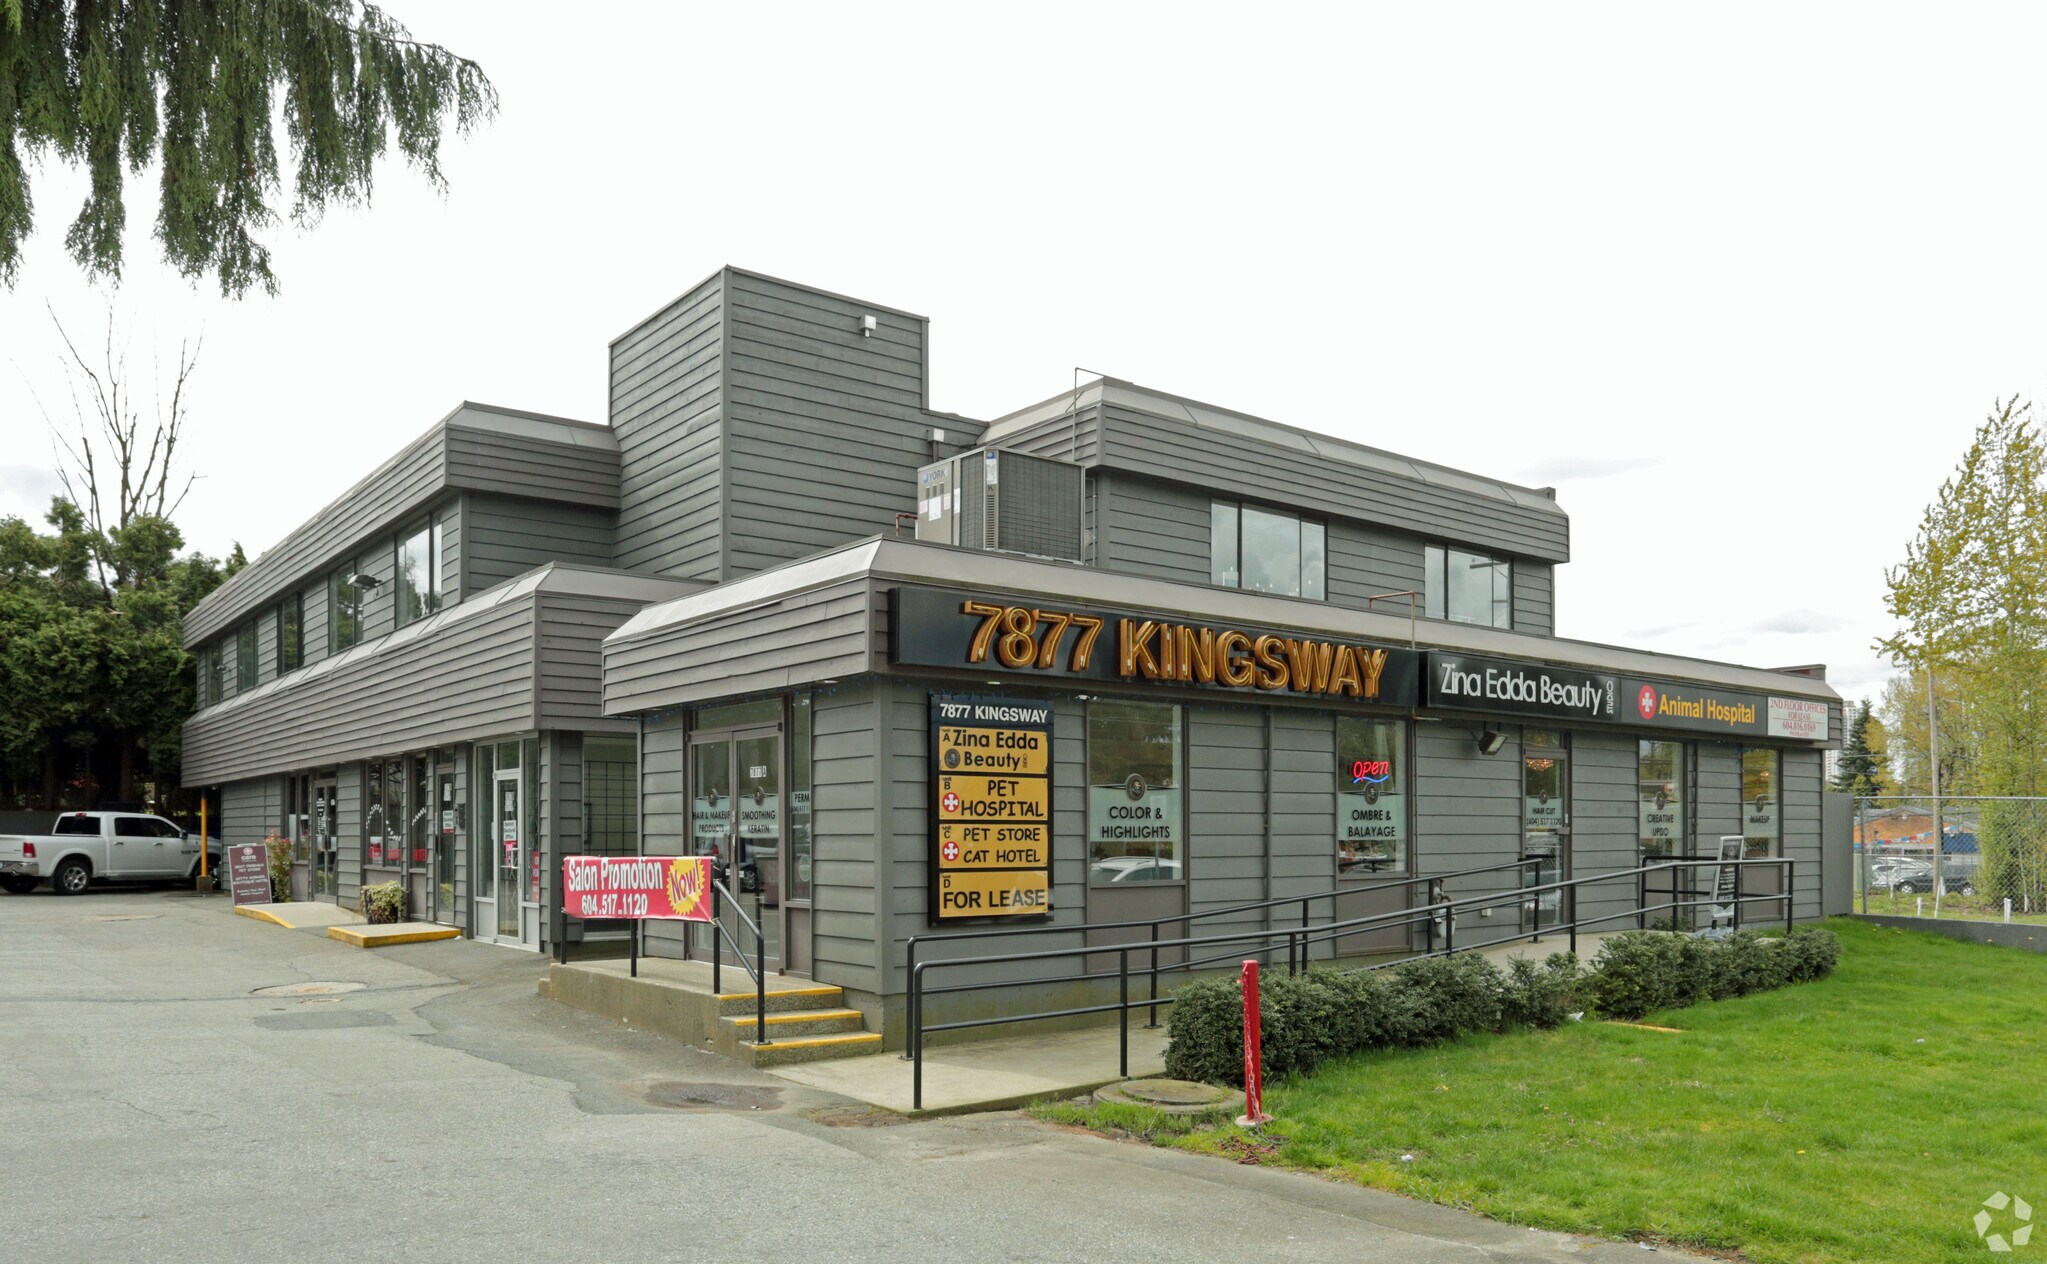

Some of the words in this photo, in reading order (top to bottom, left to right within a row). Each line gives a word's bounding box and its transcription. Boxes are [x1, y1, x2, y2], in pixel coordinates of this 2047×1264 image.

[929, 468, 946, 481] YORK
[964, 600, 1104, 672] 7877
[1120, 618, 1388, 697] KINGSWAY
[1440, 663, 1482, 696] Zina
[1486, 668, 1536, 702] Edda
[1540, 675, 1602, 716] Beauty
[1658, 694, 1704, 718] Animal
[1707, 698, 1755, 726] Hospital
[1770, 698, 1783, 709] 2ND
[1784, 700, 1803, 711] FLOOR
[1804, 702, 1826, 714] OFFICES
[940, 704, 972, 718] 7877
[974, 705, 1048, 723] KINGSWAY
[1788, 711, 1798, 720] FOR
[1798, 712, 1811, 721] LEASE
[943, 733, 950, 742] A
[953, 730, 990, 748] Zina
[996, 732, 1038, 750] Edda
[964, 751, 1020, 771] Beauty
[988, 780, 1019, 796] PET
[795, 793, 810, 802] PERM
[742, 810, 776, 820] SMOOTHING
[961, 800, 1044, 817] HOSPITAL
[1109, 806, 1151, 819] COLOR
[1155, 808, 1163, 819] &
[1352, 809, 1383, 820] OMBRE
[1386, 810, 1392, 820] &
[692, 811, 704, 820] HAIR
[1527, 818, 1539, 826] (604)
[1647, 814, 1674, 823] CREATIVE
[1750, 815, 1769, 824] MAKEUP
[698, 824, 724, 833] PRODUCTS
[748, 824, 770, 833] KERATIN
[964, 828, 990, 842] PET
[997, 828, 1040, 842] STORE
[1101, 826, 1170, 838] HIGHLIGHTS
[1348, 826, 1396, 837] BALAYAGE
[1652, 828, 1668, 836] UPDO
[963, 850, 990, 863] CAT
[996, 849, 1040, 863] HOTEL
[568, 858, 598, 891] Salon
[600, 857, 663, 890] Promotion
[668, 858, 701, 906] Now!
[944, 879, 951, 888] D
[581, 894, 648, 915] 604.517.1120
[943, 891, 981, 909] FOR
[989, 889, 1045, 908] LEASE
